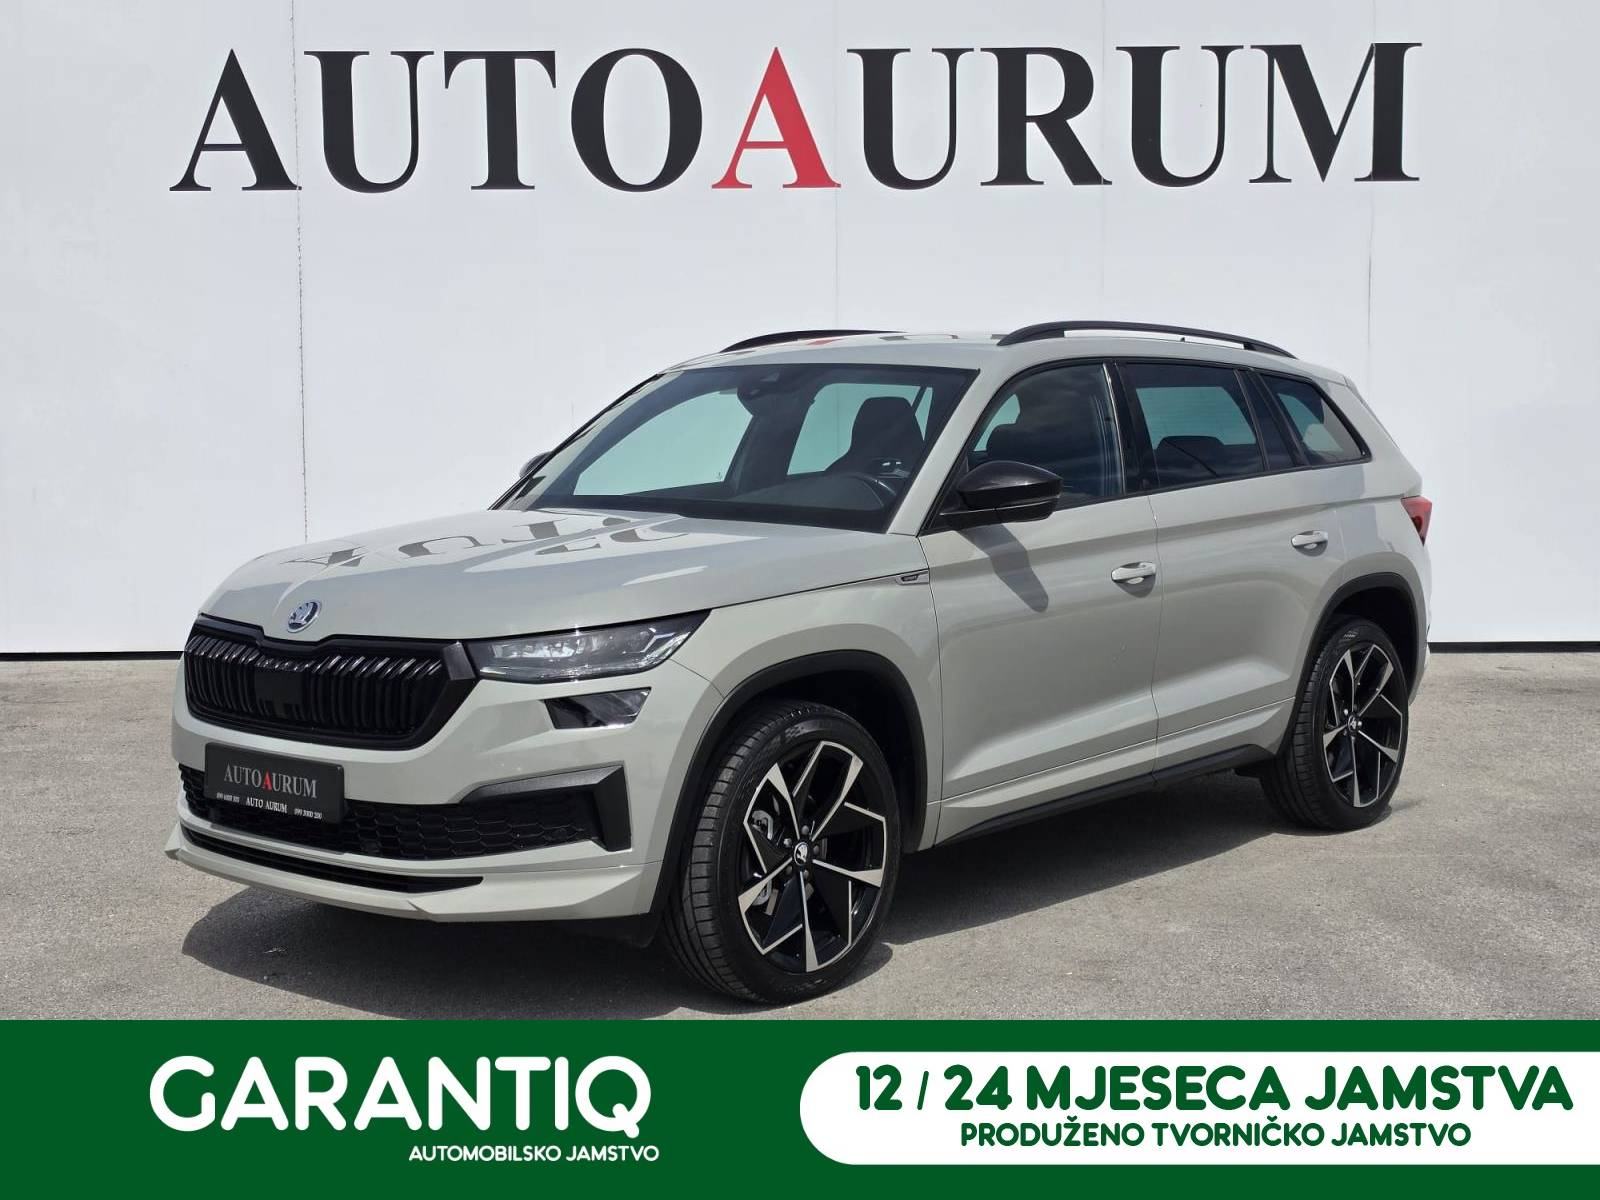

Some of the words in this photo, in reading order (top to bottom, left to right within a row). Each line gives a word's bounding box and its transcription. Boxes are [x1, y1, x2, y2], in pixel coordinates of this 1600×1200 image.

[169, 42, 1422, 193] AUTOAURUM
[223, 762, 317, 798] AUTOAURUM
[245, 796, 263, 808] AUTO
[266, 800, 287, 813] AURUM
